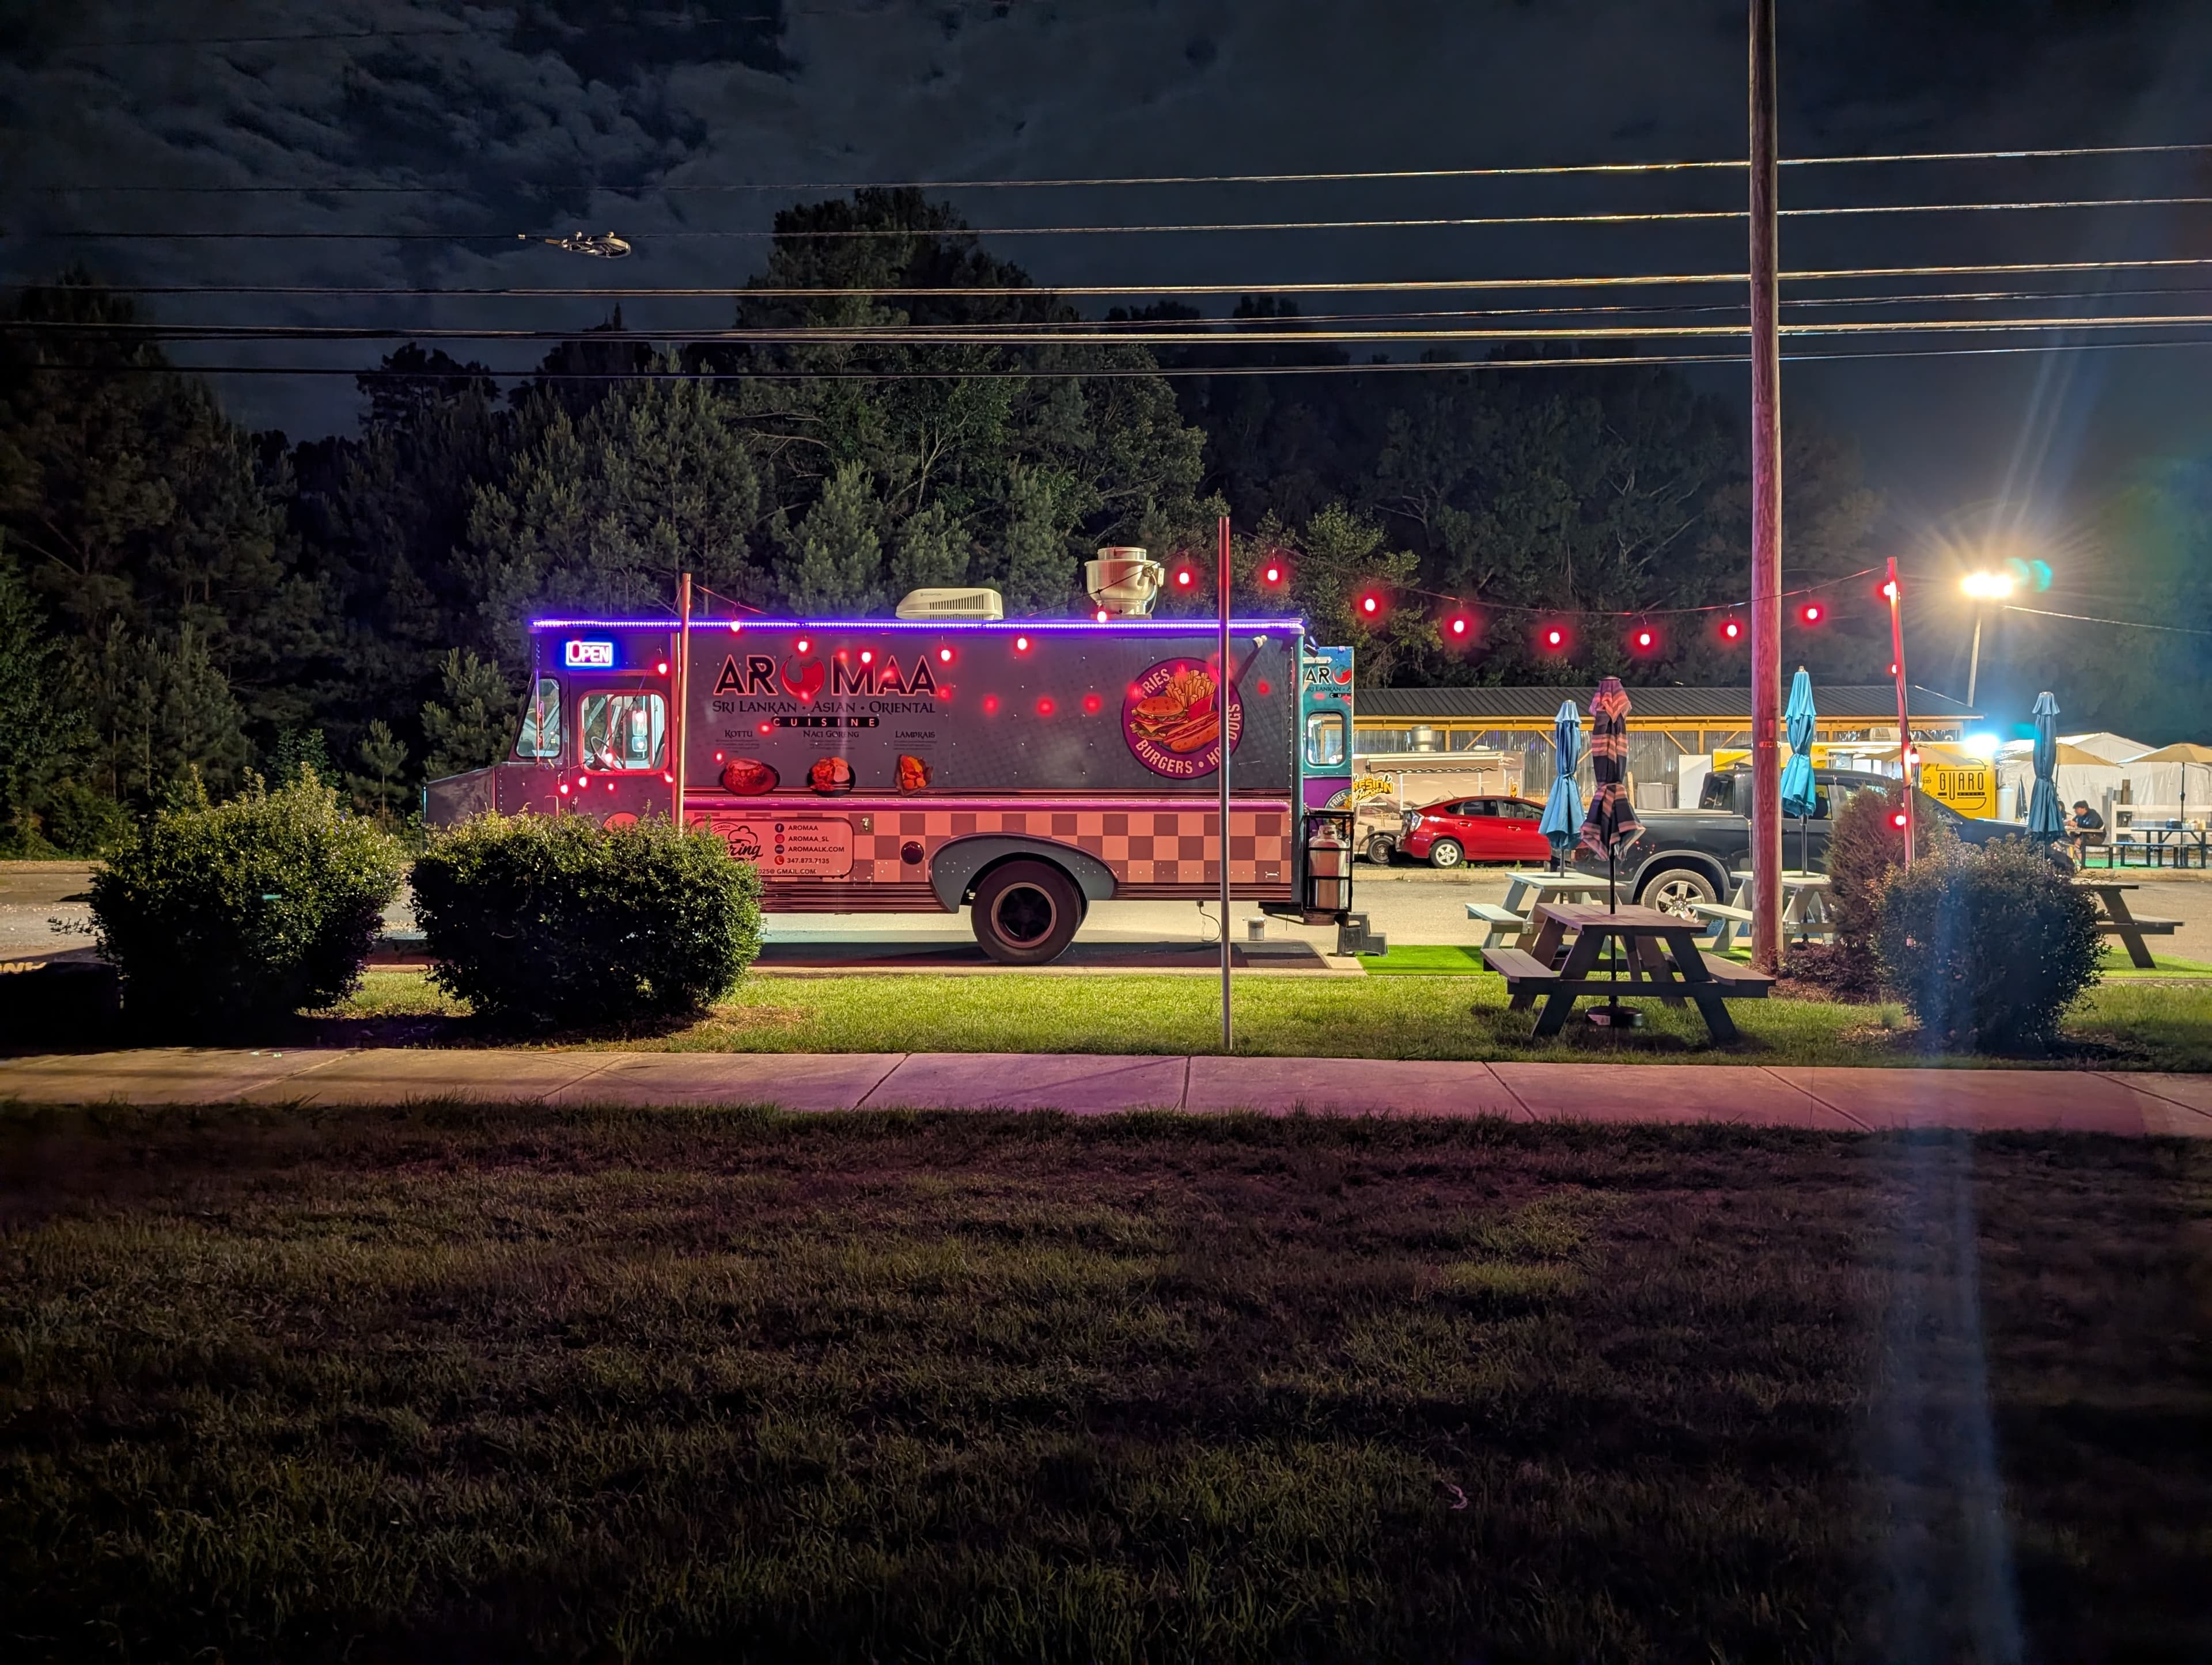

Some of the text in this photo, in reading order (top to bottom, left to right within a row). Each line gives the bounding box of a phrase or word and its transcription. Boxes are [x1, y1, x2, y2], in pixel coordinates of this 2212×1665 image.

[570, 640, 609, 662] OPEN
[713, 700, 935, 714] SRI LANKAN ASIAN ORIENTAL
[773, 718, 874, 726] CUISINE
[725, 730, 752, 738] KOTTU
[1135, 739, 1193, 773] BURGERS
[1353, 779, 1393, 794] RESIÓN
[1940, 772, 1983, 800] GUARO
[1329, 792, 1347, 808] FRIES
[1355, 788, 1384, 801] Burger
[728, 843, 763, 860] ring
